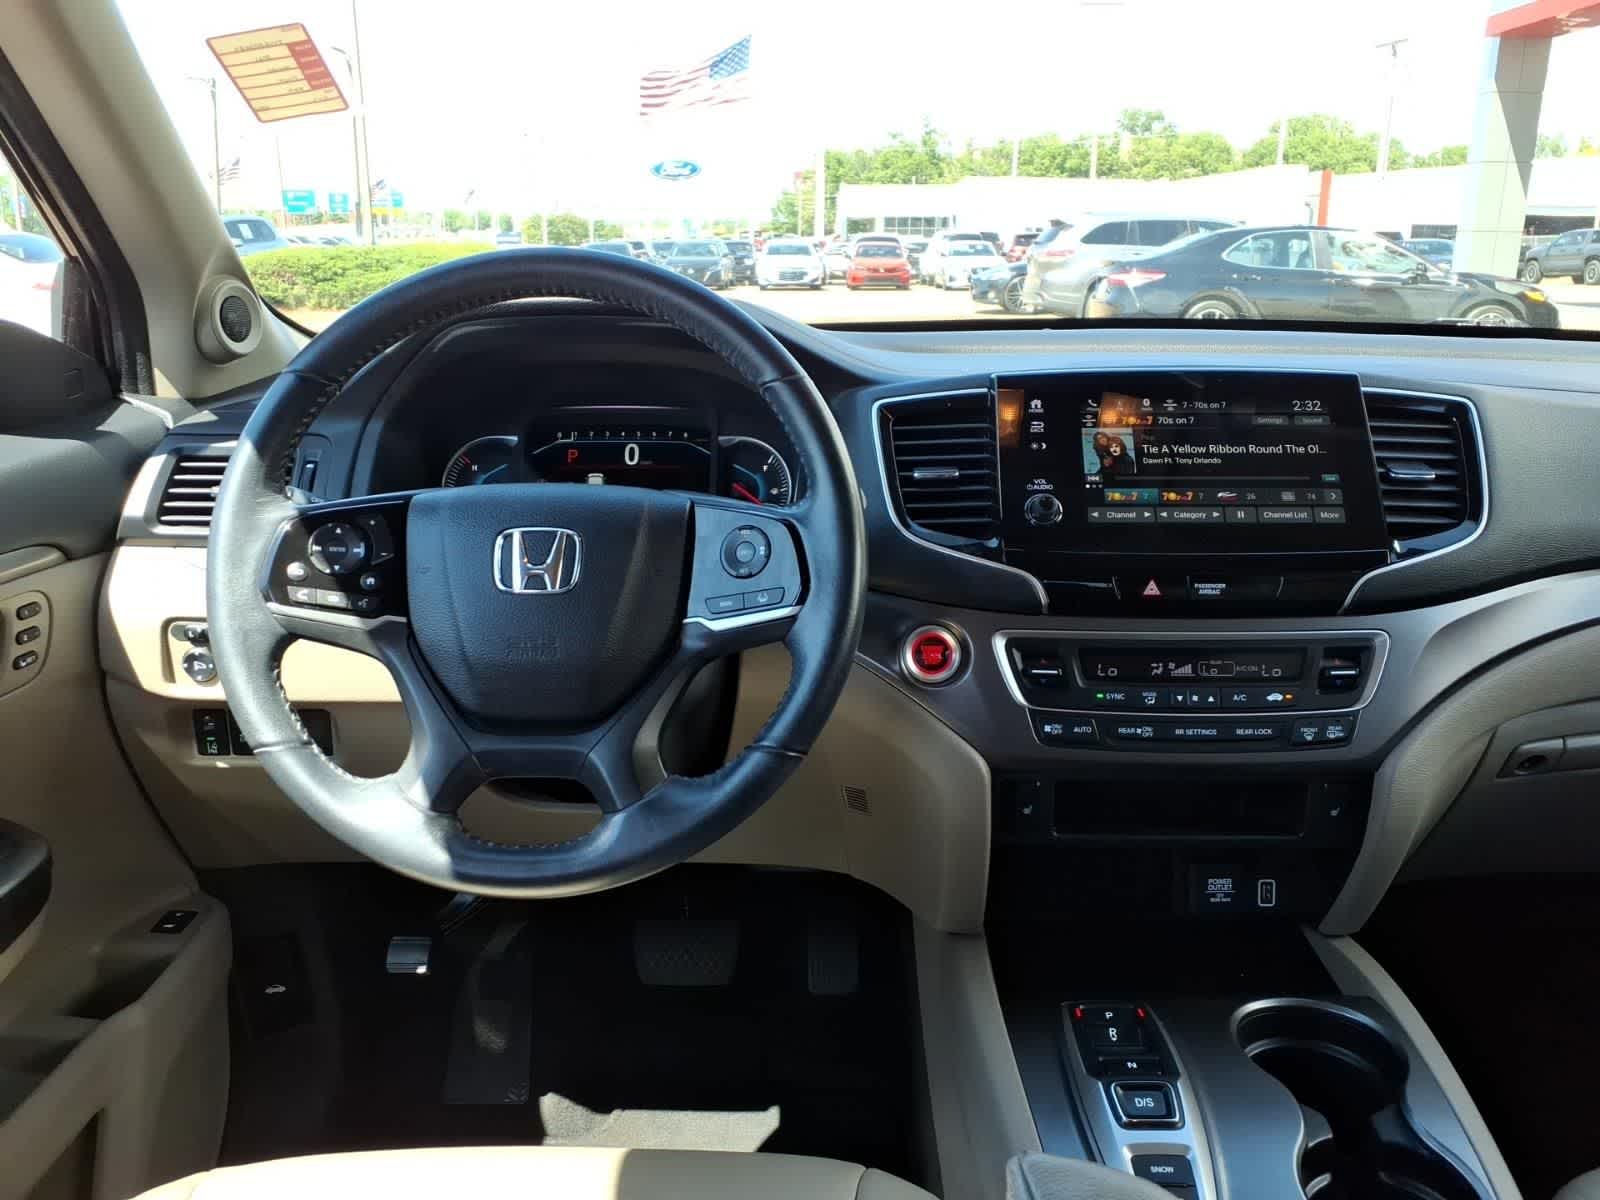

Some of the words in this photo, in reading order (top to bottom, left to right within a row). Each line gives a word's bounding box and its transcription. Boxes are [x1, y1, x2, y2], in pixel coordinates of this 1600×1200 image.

[1292, 400, 1322, 411] 2:32
[1188, 416, 1194, 424] 7
[1142, 444, 1159, 453] Tie
[1161, 445, 1170, 453] A
[1170, 444, 1206, 453] Yellow
[1209, 444, 1246, 453] Ribbon
[1248, 444, 1283, 453] Round
[1284, 444, 1305, 453] The
[568, 449, 578, 462] P
[624, 443, 639, 465] 0
[1175, 457, 1192, 465] Tony
[1106, 511, 1137, 519] Channel
[1174, 511, 1207, 520] Category
[1263, 511, 1293, 519] Channel
[1294, 511, 1308, 519] List
[1320, 511, 1339, 519] More
[1105, 1011, 1113, 1020] P
[1134, 1097, 1154, 1107] D/S
